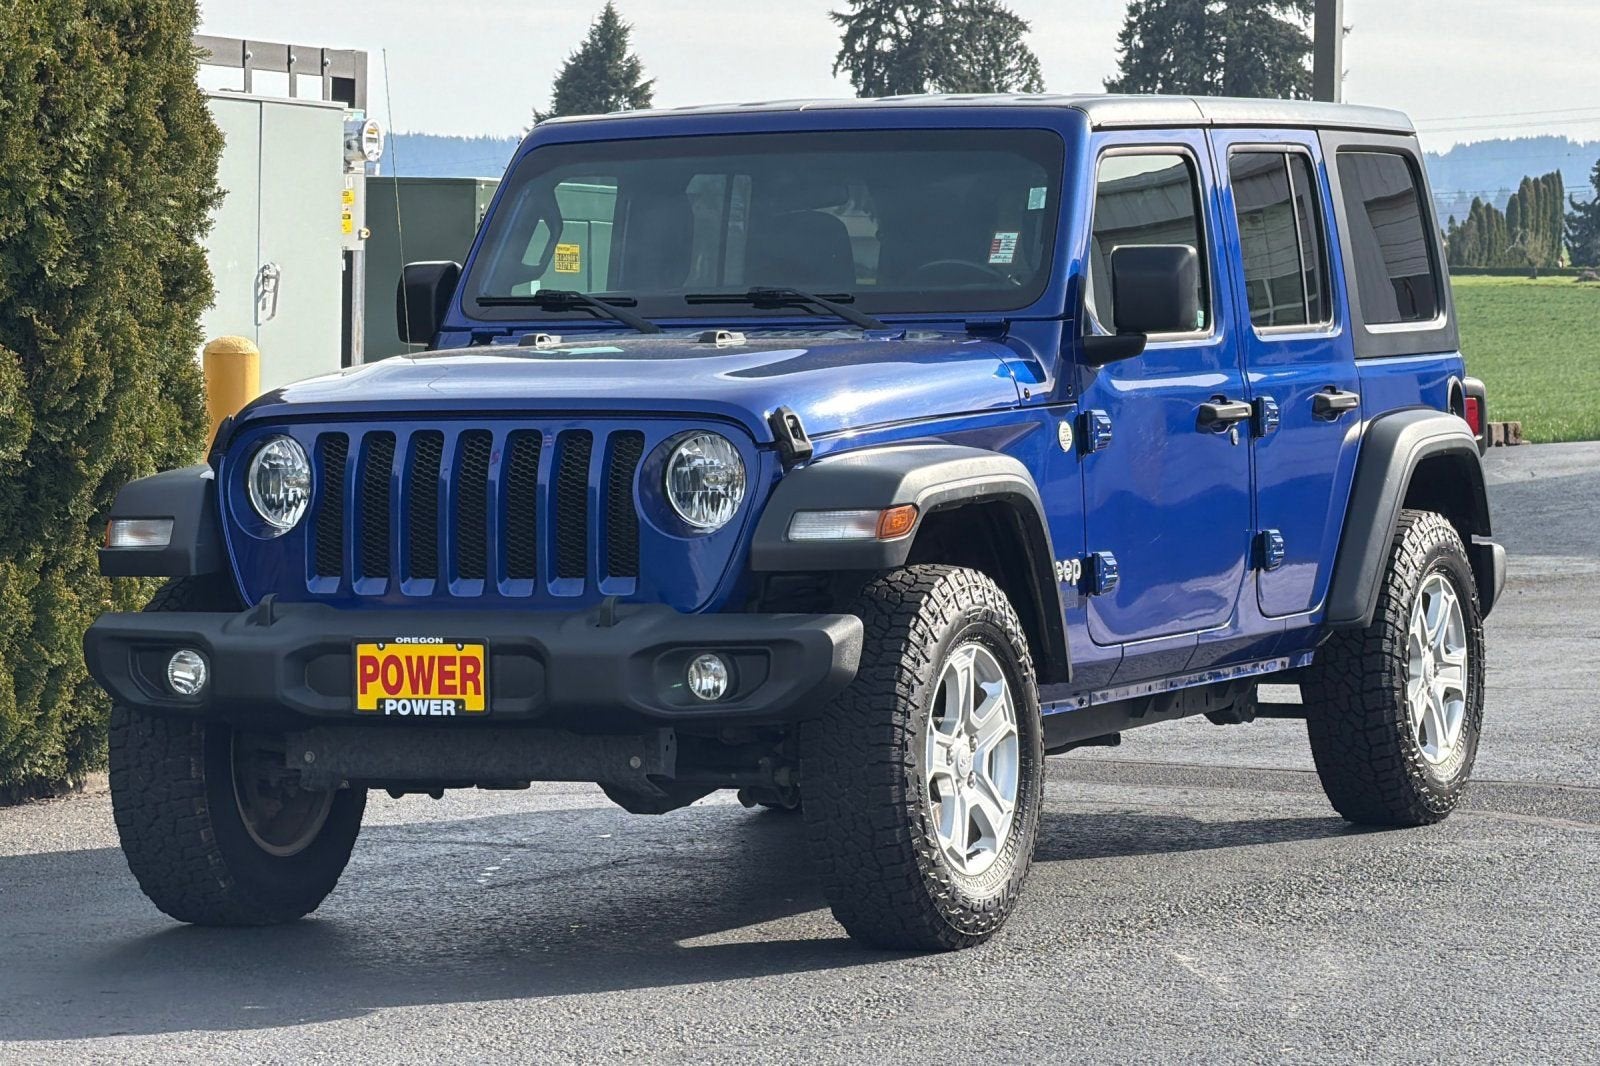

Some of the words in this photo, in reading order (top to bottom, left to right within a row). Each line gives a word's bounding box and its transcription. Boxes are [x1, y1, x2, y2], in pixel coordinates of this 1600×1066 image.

[1055, 558, 1082, 586] eep
[359, 654, 482, 696] POWER
[385, 699, 456, 716] POWER
